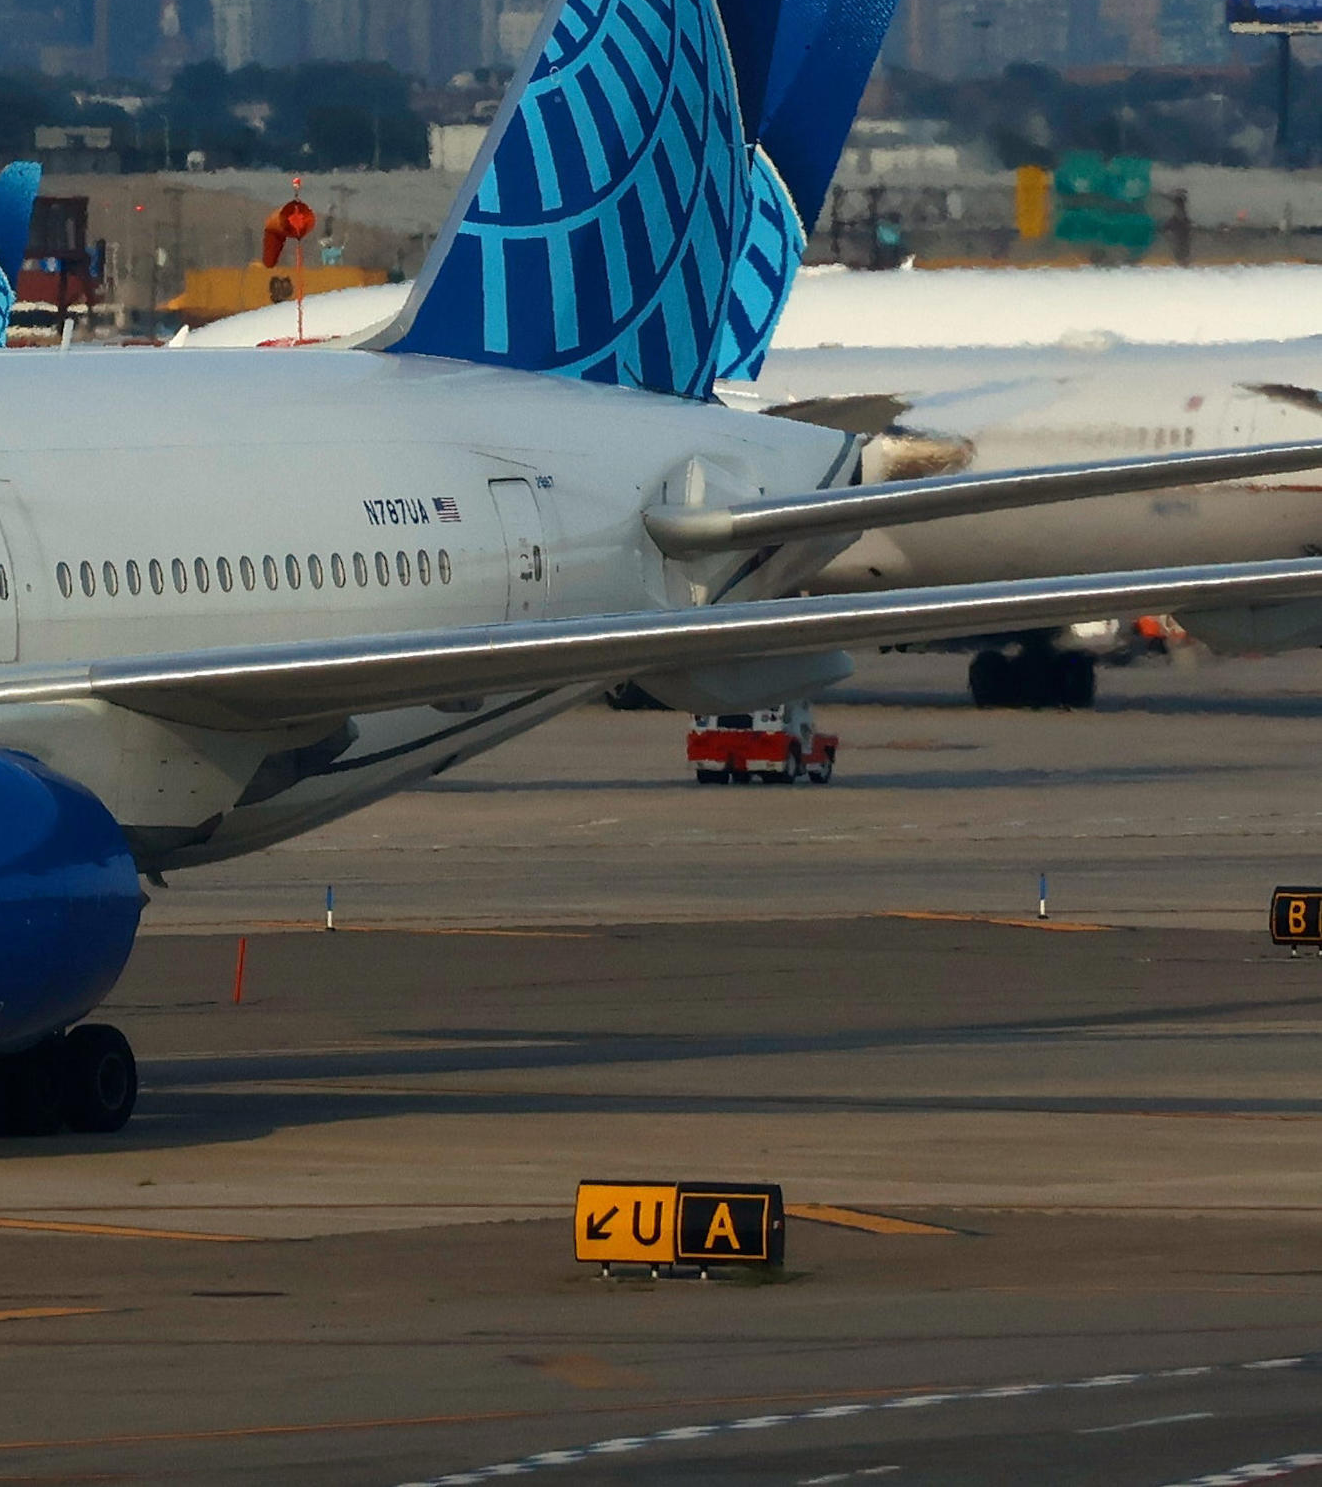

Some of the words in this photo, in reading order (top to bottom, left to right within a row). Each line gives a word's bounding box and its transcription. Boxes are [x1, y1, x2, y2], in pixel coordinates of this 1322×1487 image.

[363, 497, 430, 525] N787UA
[632, 1201, 663, 1246] U
[704, 1202, 741, 1250] A
